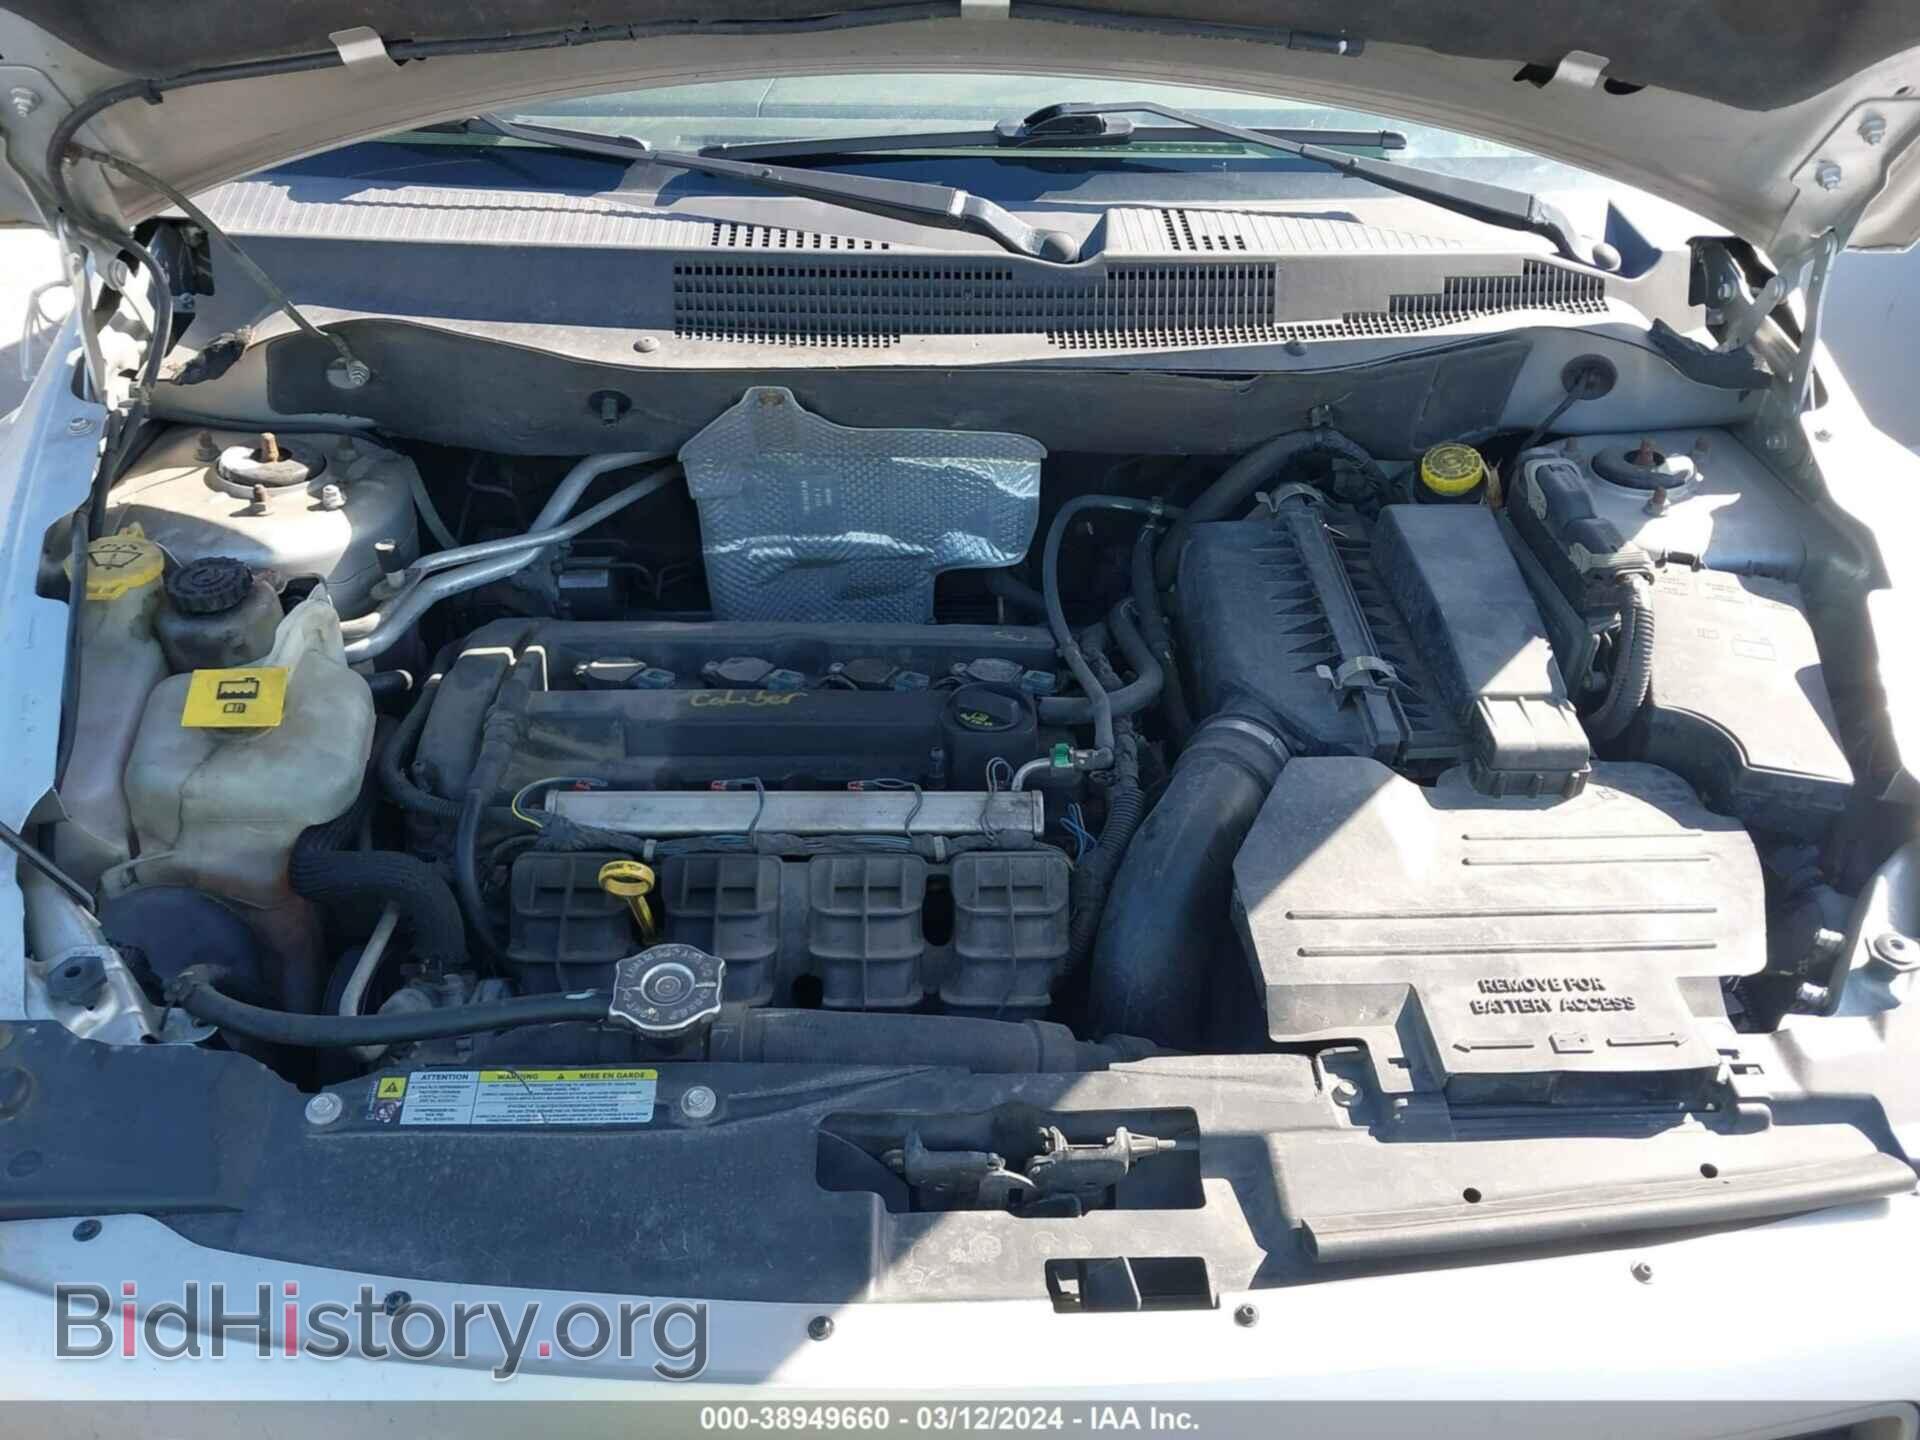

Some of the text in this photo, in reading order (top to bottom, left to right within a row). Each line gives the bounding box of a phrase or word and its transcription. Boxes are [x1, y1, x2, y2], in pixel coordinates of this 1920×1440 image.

[1477, 976, 1607, 994] REMOVE FOR
[1469, 996, 1636, 1015] BATTERY ACCESS
[420, 1073, 469, 1081] ATTENTION
[579, 1071, 646, 1080] MISE EN GARDE
